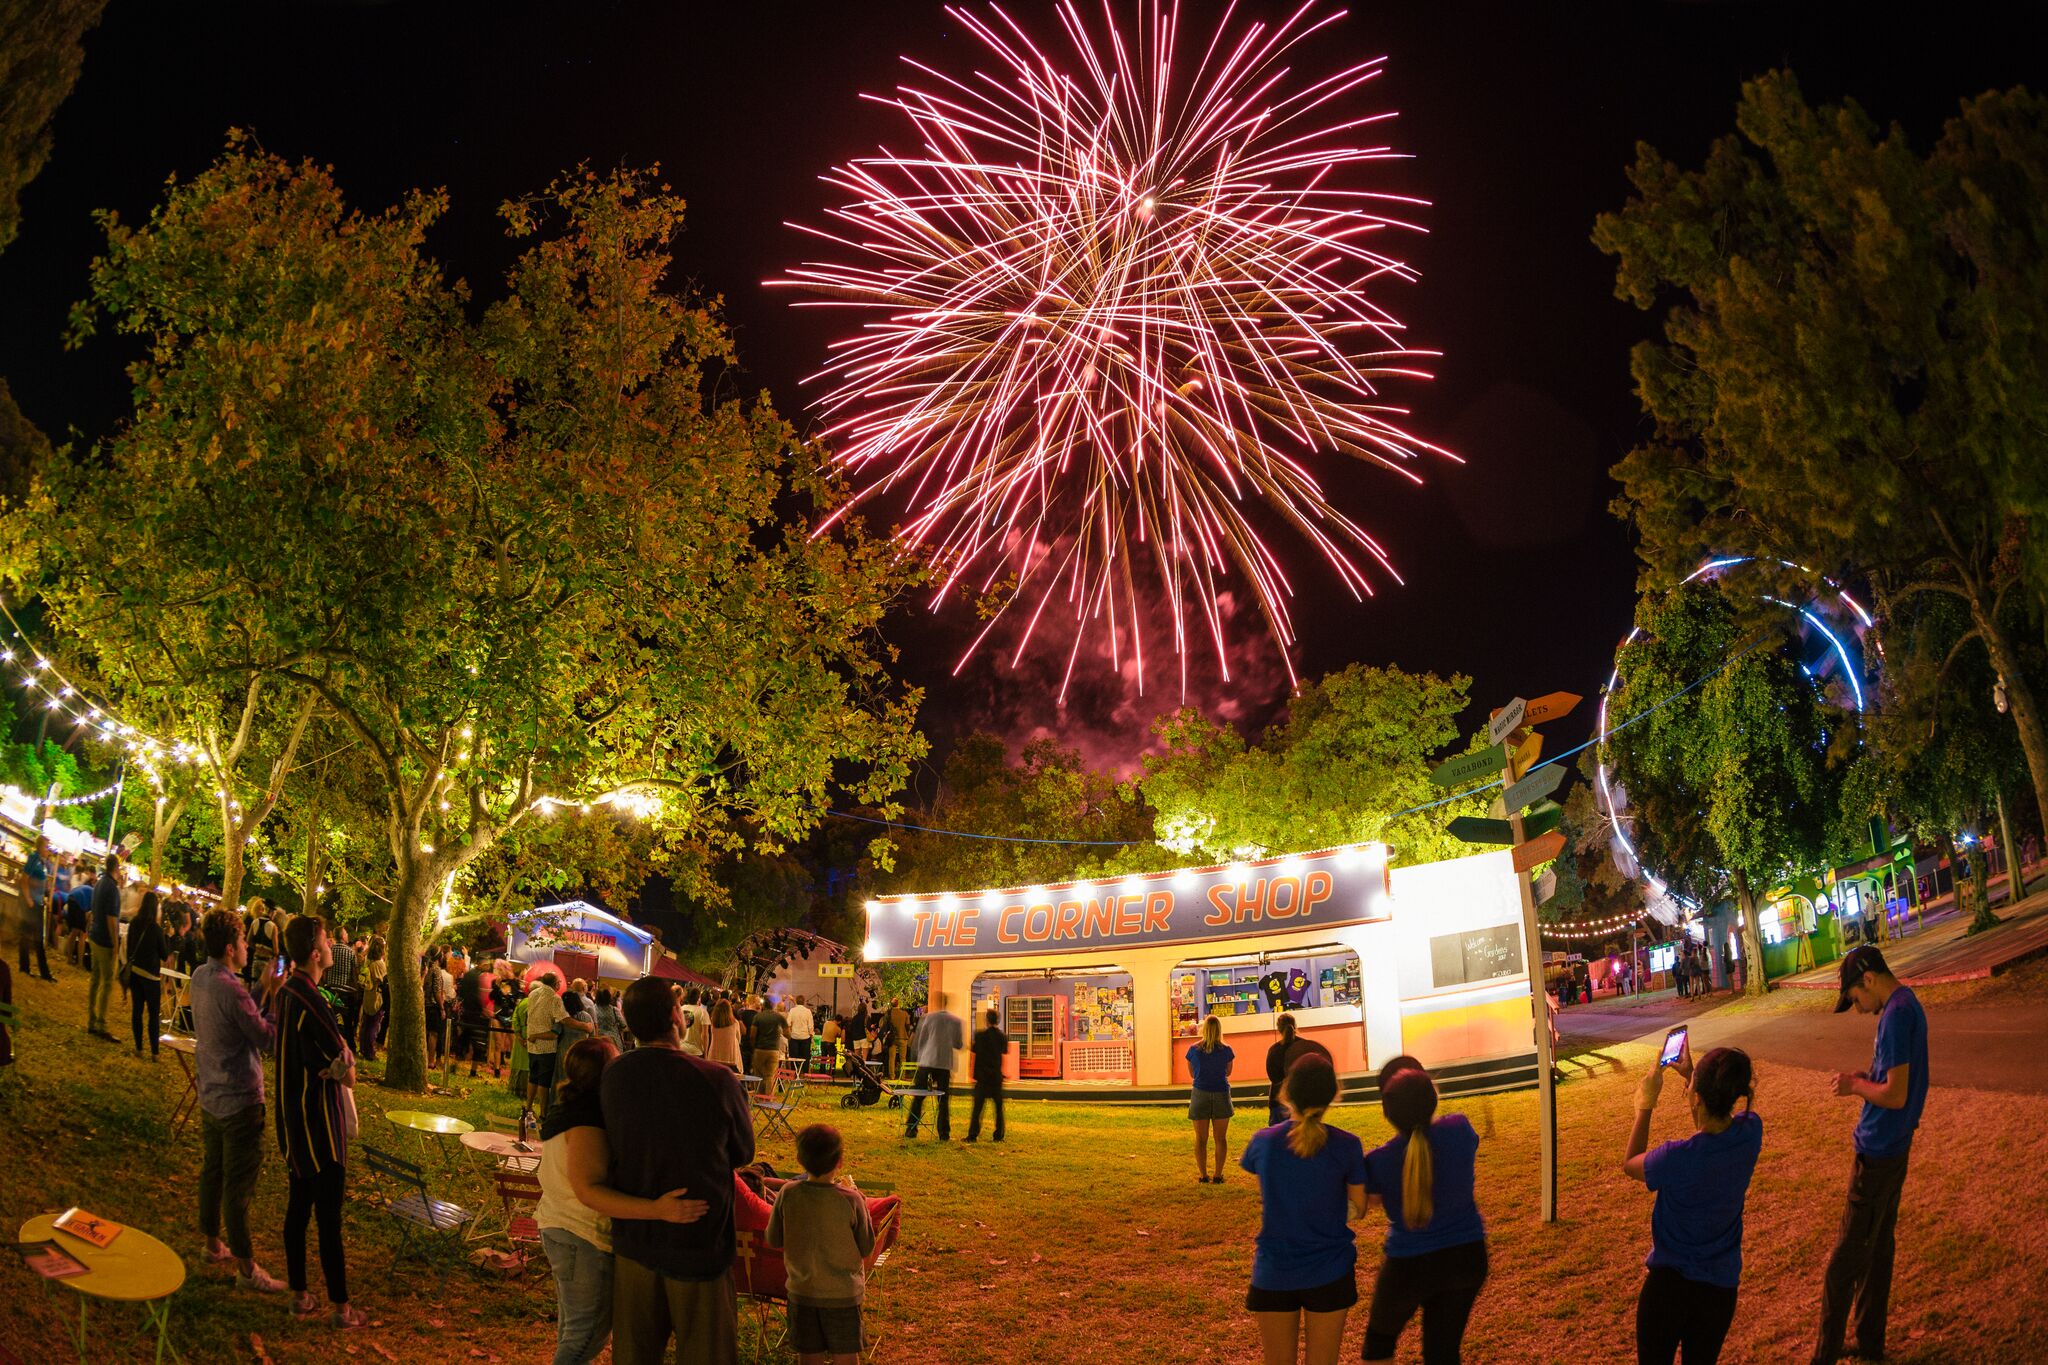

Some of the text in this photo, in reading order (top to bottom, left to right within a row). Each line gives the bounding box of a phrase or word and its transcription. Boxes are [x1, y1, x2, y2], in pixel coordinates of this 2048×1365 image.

[1526, 705, 1549, 718] LETS
[1451, 757, 1493, 777] VAGABOND
[912, 870, 1334, 948] THE CORNER SHOP
